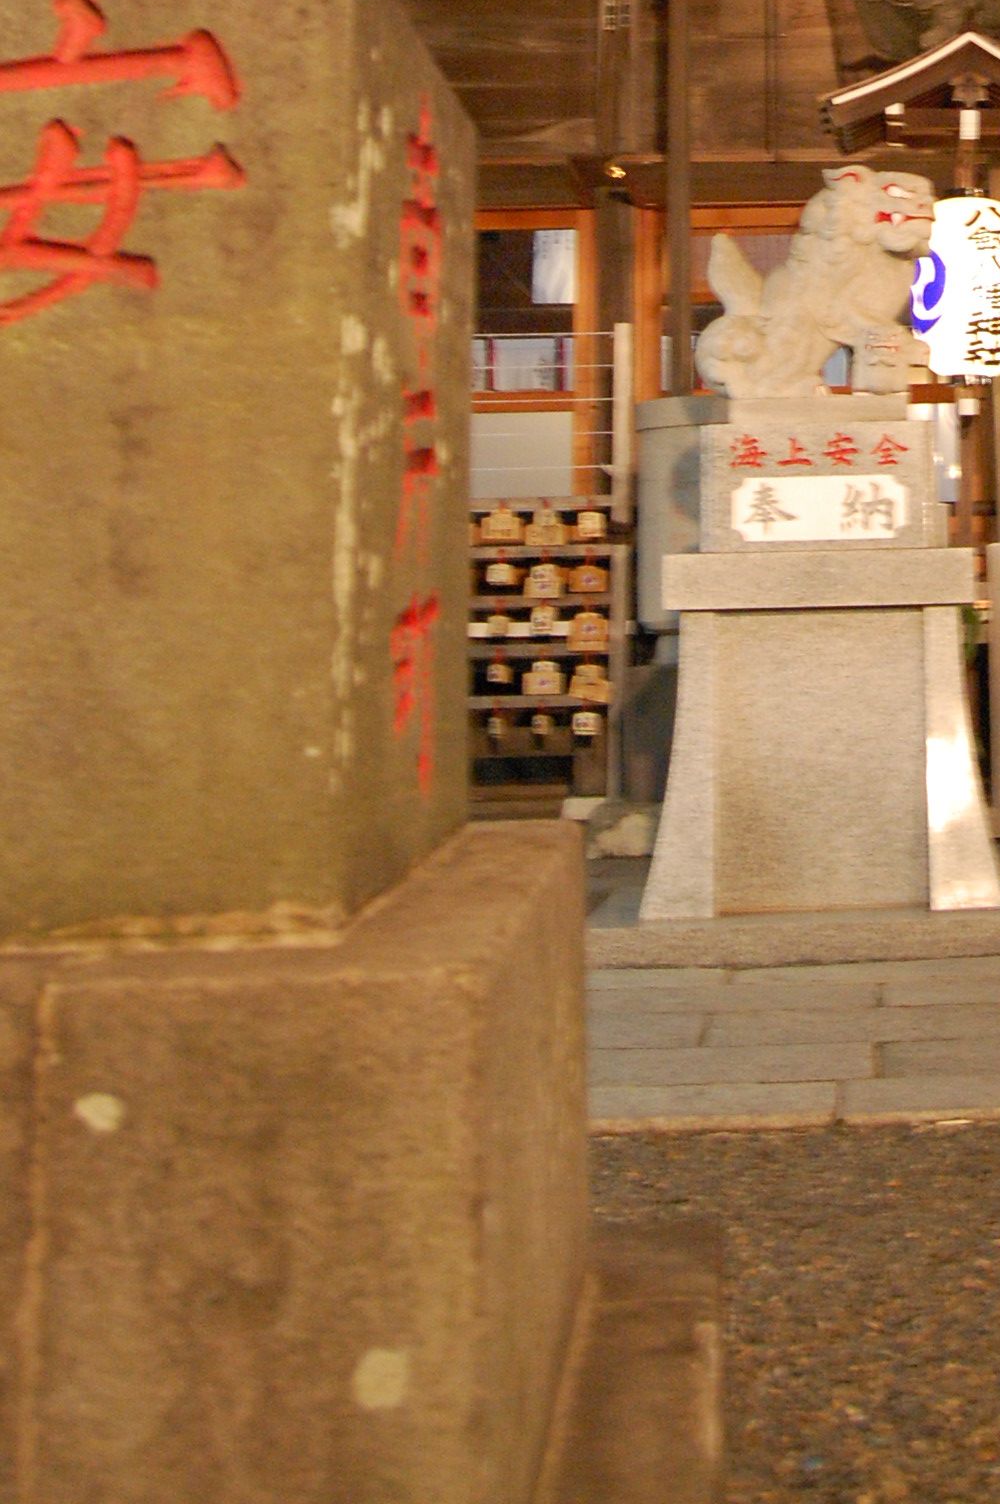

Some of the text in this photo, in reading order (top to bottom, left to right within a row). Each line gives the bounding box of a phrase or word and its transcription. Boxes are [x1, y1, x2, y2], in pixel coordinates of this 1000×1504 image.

[729, 432, 911, 468] 海上安全
[743, 481, 896, 535] 奉納
